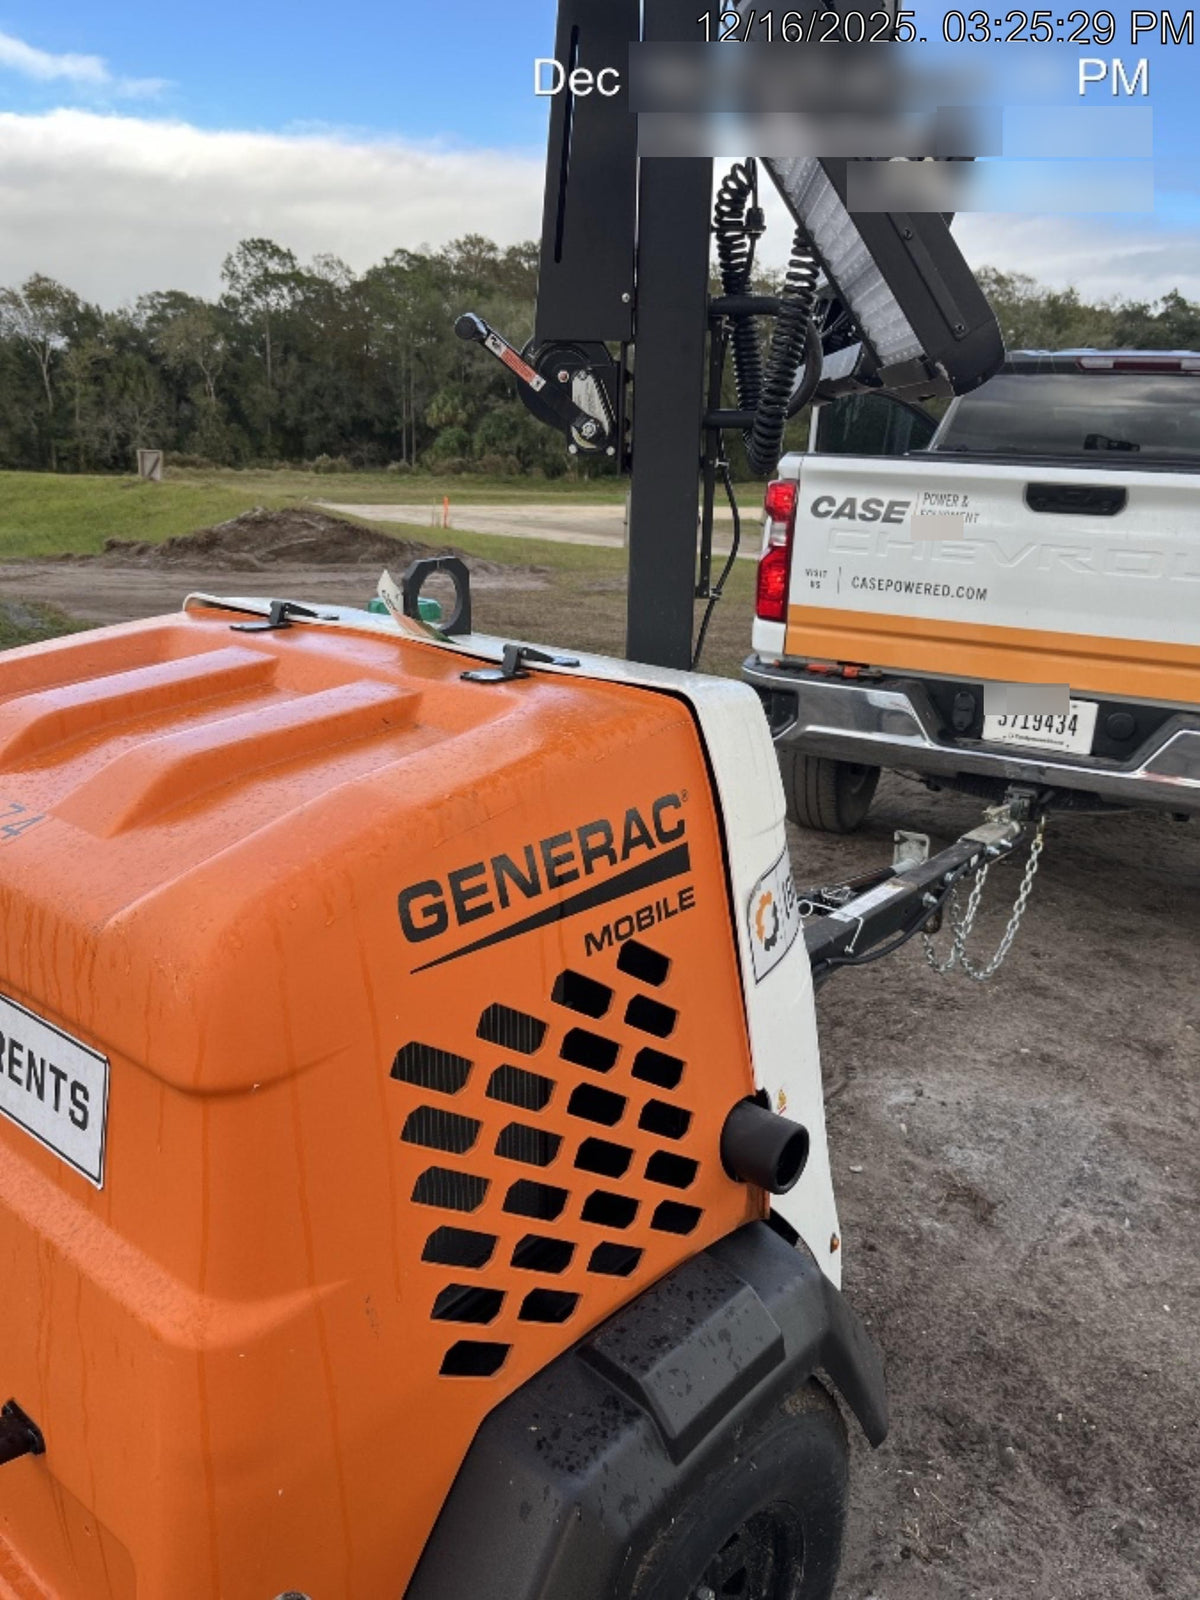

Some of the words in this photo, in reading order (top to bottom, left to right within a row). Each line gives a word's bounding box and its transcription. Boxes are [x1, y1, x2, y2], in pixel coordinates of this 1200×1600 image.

[810, 495, 912, 524] CASE
[922, 491, 960, 508] POWER
[805, 568, 828, 579] VISIT
[851, 575, 988, 601] CASEPOWERED.COM
[583, 885, 696, 957] MOBILE
